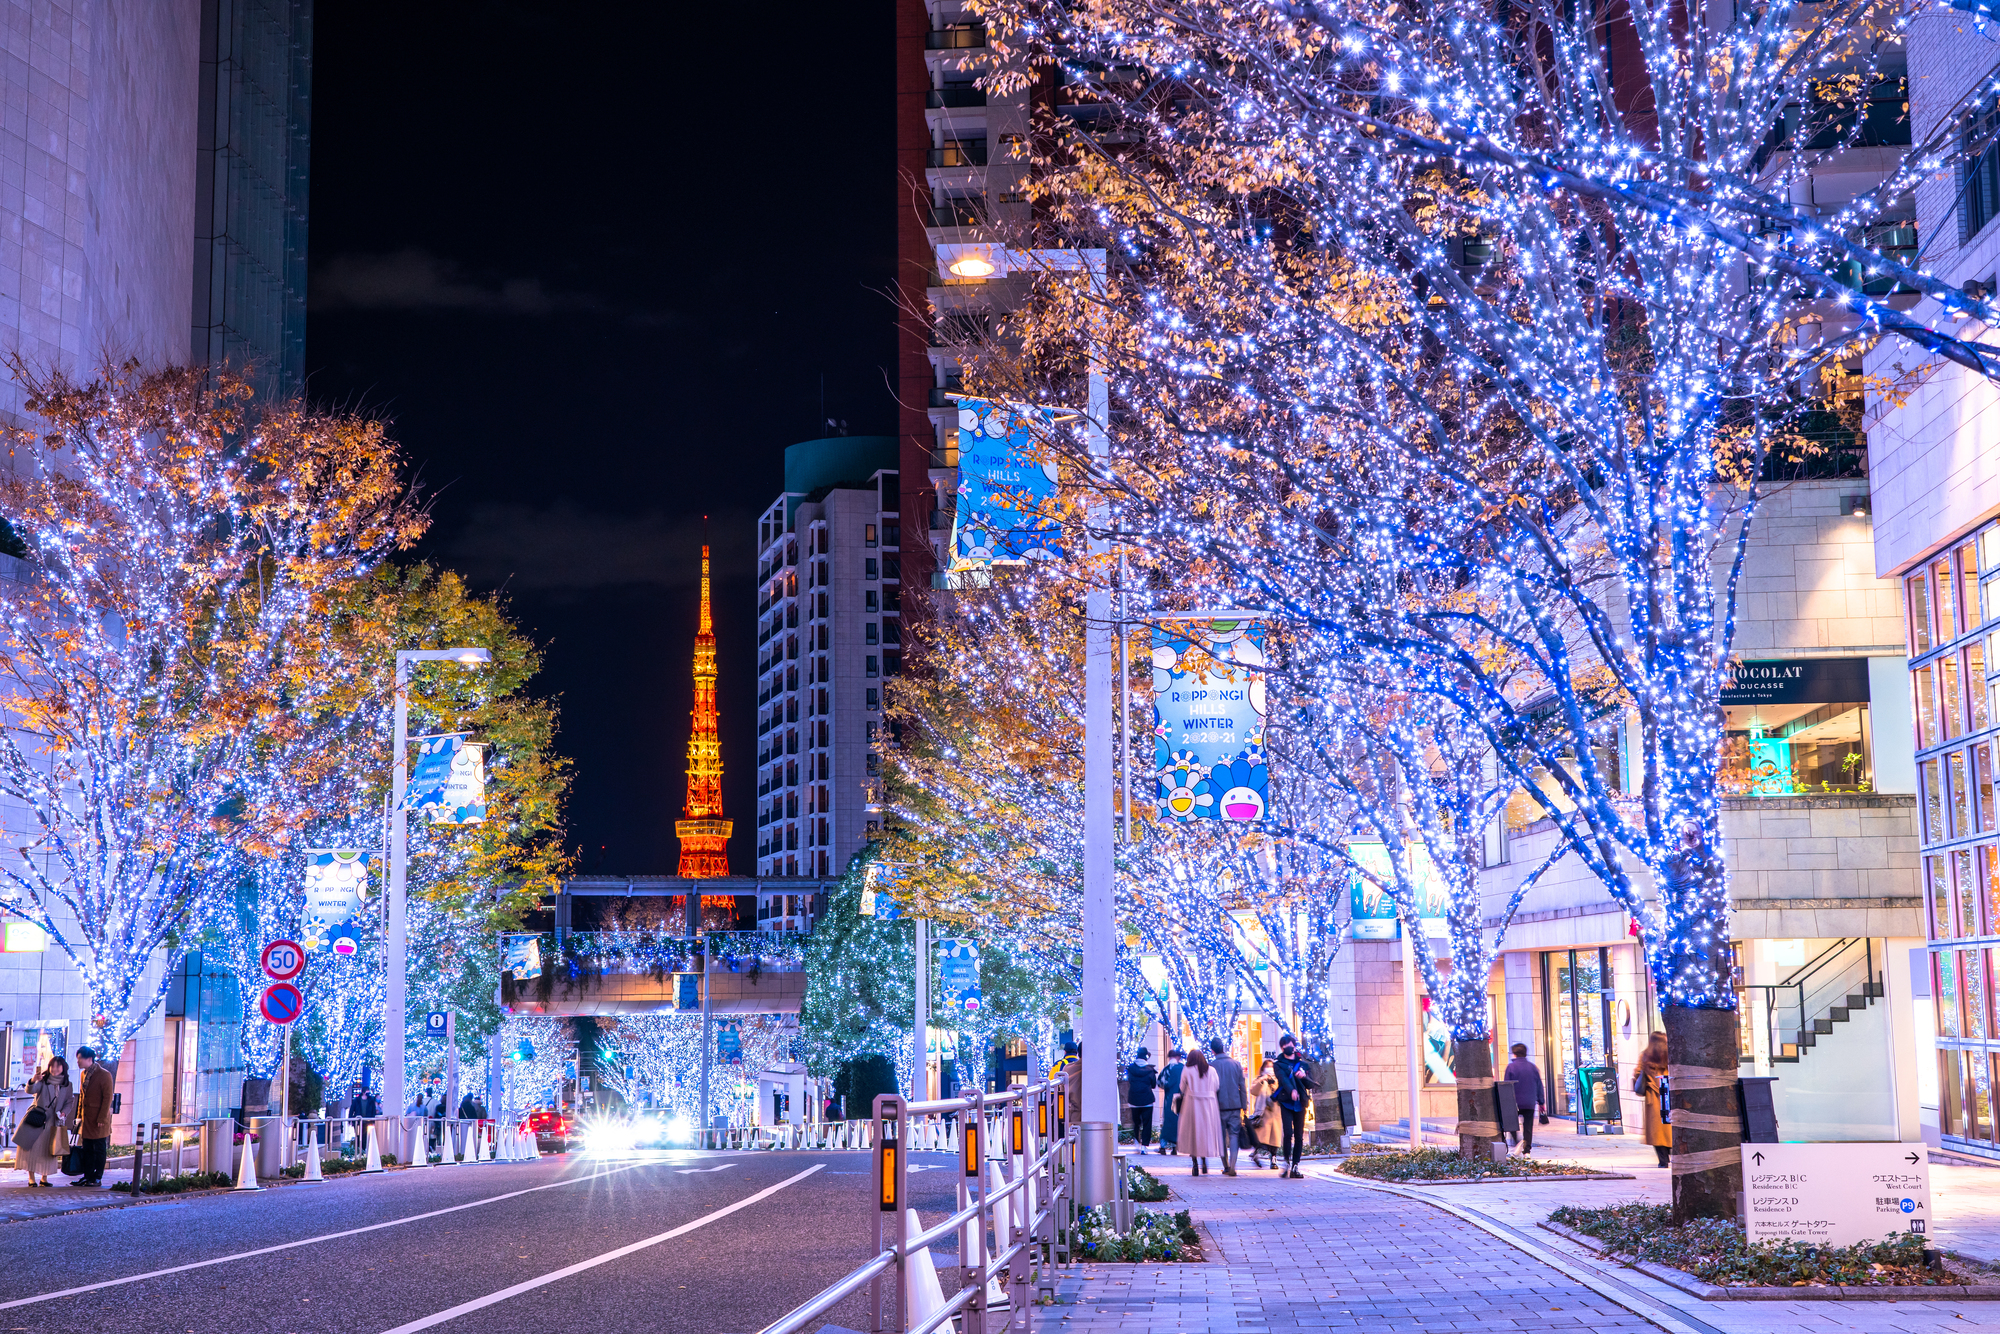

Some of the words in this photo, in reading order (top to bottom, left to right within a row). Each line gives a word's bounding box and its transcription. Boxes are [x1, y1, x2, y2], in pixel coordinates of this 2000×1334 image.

[988, 469, 1020, 482] HILLS
[1726, 666, 1803, 679] HOCOLAT
[1740, 682, 1784, 690] DUCASSE
[1172, 689, 1244, 702] ROPPONGI
[1190, 704, 1226, 715] HILLS
[1183, 717, 1234, 730] WINTER
[1182, 731, 1236, 744] 2020-21
[271, 951, 295, 969] 50
[1751, 1174, 1788, 1183] レジデンス
[1872, 1174, 1922, 1182] ウエストコート
[1753, 1197, 1790, 1205] レジデンス
[1791, 1197, 1799, 1205] D
[1875, 1197, 1900, 1206] 駐車場
[1902, 1201, 1914, 1210] P9
[1917, 1201, 1924, 1209] A
[1876, 1206, 1901, 1214] Parking
[1791, 1220, 1836, 1228] ゲートタワー
